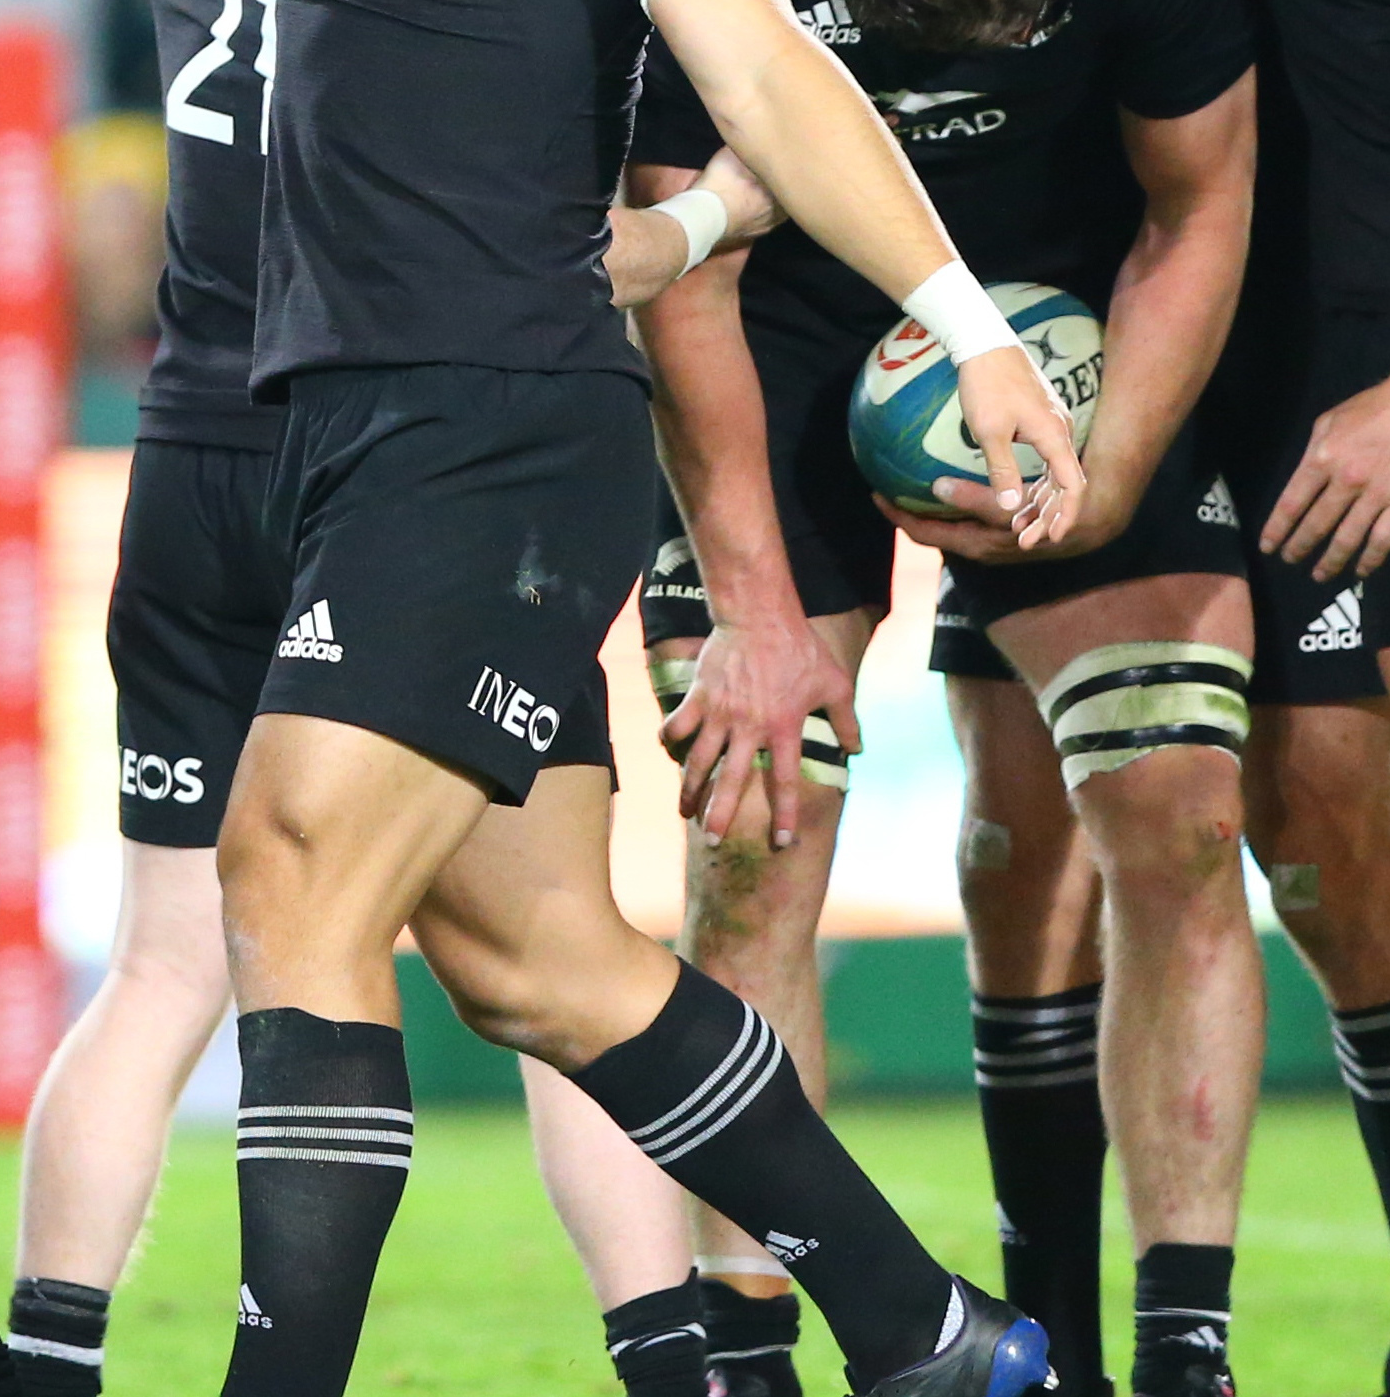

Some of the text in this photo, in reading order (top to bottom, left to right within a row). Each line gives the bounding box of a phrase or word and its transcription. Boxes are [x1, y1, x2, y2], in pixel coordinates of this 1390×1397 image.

[666, 584, 706, 600] BLAC
[278, 636, 344, 663] adidas
[1299, 624, 1363, 652] adid
[467, 665, 561, 753] INEO
[121, 747, 205, 804] EOS
